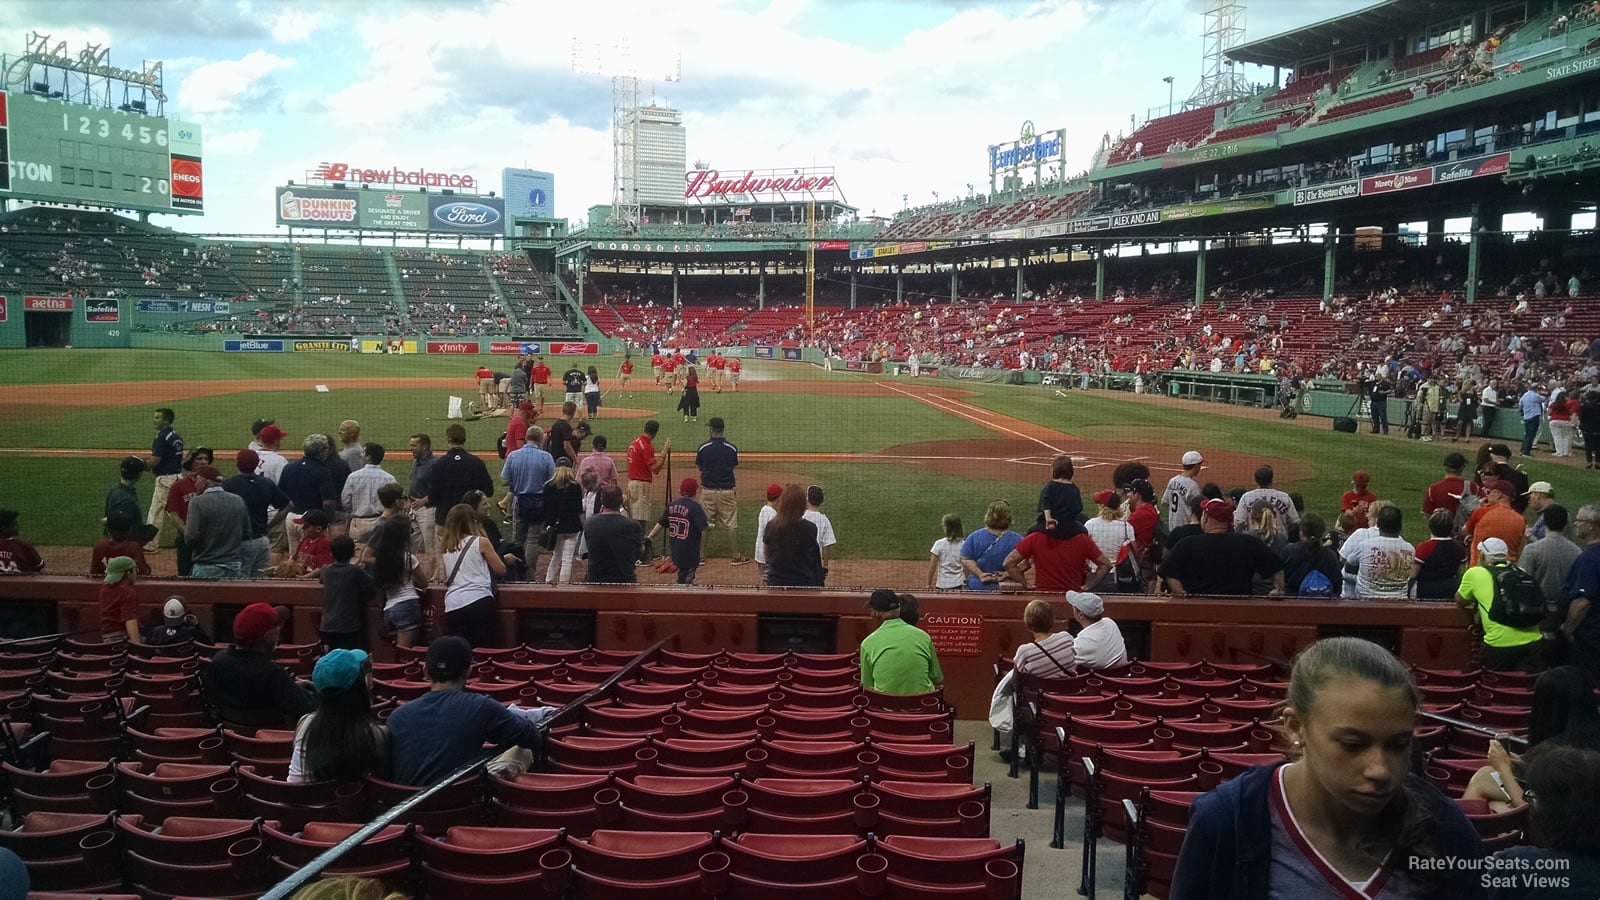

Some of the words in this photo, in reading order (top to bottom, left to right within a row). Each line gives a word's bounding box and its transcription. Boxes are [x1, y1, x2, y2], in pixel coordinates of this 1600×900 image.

[5, 30, 73, 86] John
[73, 42, 168, 103] Hancock
[1546, 64, 1571, 80] STATE
[1572, 56, 1600, 73] STREE
[63, 113, 68, 131] 1
[79, 116, 91, 135] 2
[98, 119, 110, 138] 3
[121, 123, 134, 141] 4
[139, 127, 151, 144] 5
[155, 129, 168, 146] 6
[991, 131, 1061, 169] Cumberland
[1191, 150, 1208, 161] JUNE
[1222, 144, 1238, 156] 2016
[173, 173, 200, 183] ENEOS
[351, 168, 390, 184] new
[393, 166, 474, 188] balance
[1439, 167, 1473, 181] Safelite
[141, 177, 152, 193] 2
[158, 179, 169, 195] 0
[685, 169, 834, 198] Budweiser
[1375, 179, 1394, 189] Ninety
[1296, 192, 1305, 203] B
[1307, 190, 1317, 201] The
[1318, 188, 1338, 199] Boston
[1338, 184, 1356, 195] Globe
[302, 199, 355, 210] DUNKIN'
[302, 209, 352, 220] DONUTS
[447, 206, 487, 223] Ford
[1114, 216, 1130, 226] ALEX
[1130, 214, 1146, 224] AND
[1146, 211, 1159, 222] ANI
[32, 298, 65, 309] aetna
[87, 305, 118, 313] Safelite
[240, 341, 268, 350] jetBlue
[295, 342, 330, 350] GRANITE
[332, 342, 348, 350] CITY
[438, 344, 468, 353] xfinity
[1171, 493, 1179, 513] 9
[668, 516, 690, 539] 50
[928, 617, 981, 625] CAUTION!
